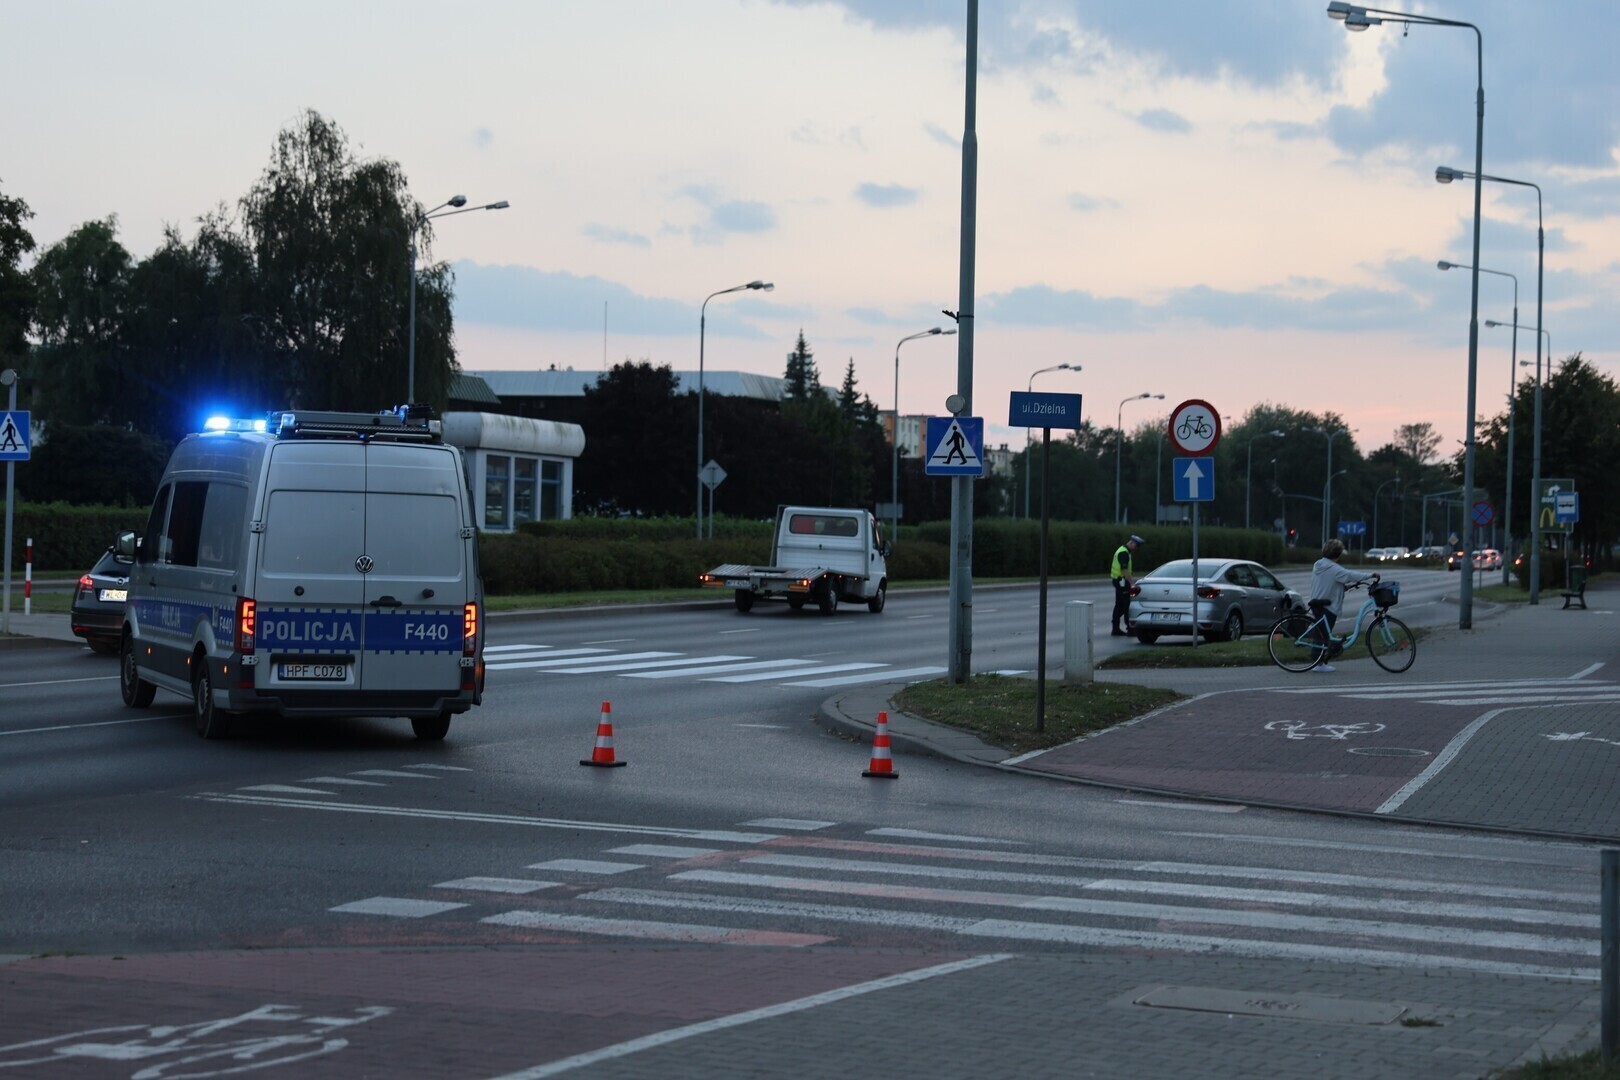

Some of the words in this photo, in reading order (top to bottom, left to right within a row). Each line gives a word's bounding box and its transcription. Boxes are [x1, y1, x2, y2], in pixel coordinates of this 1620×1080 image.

[219, 616, 233, 634] F440
[262, 620, 355, 642] POLICJA
[404, 623, 449, 641] F440
[286, 665, 309, 677] HPF
[313, 665, 343, 677] C078
